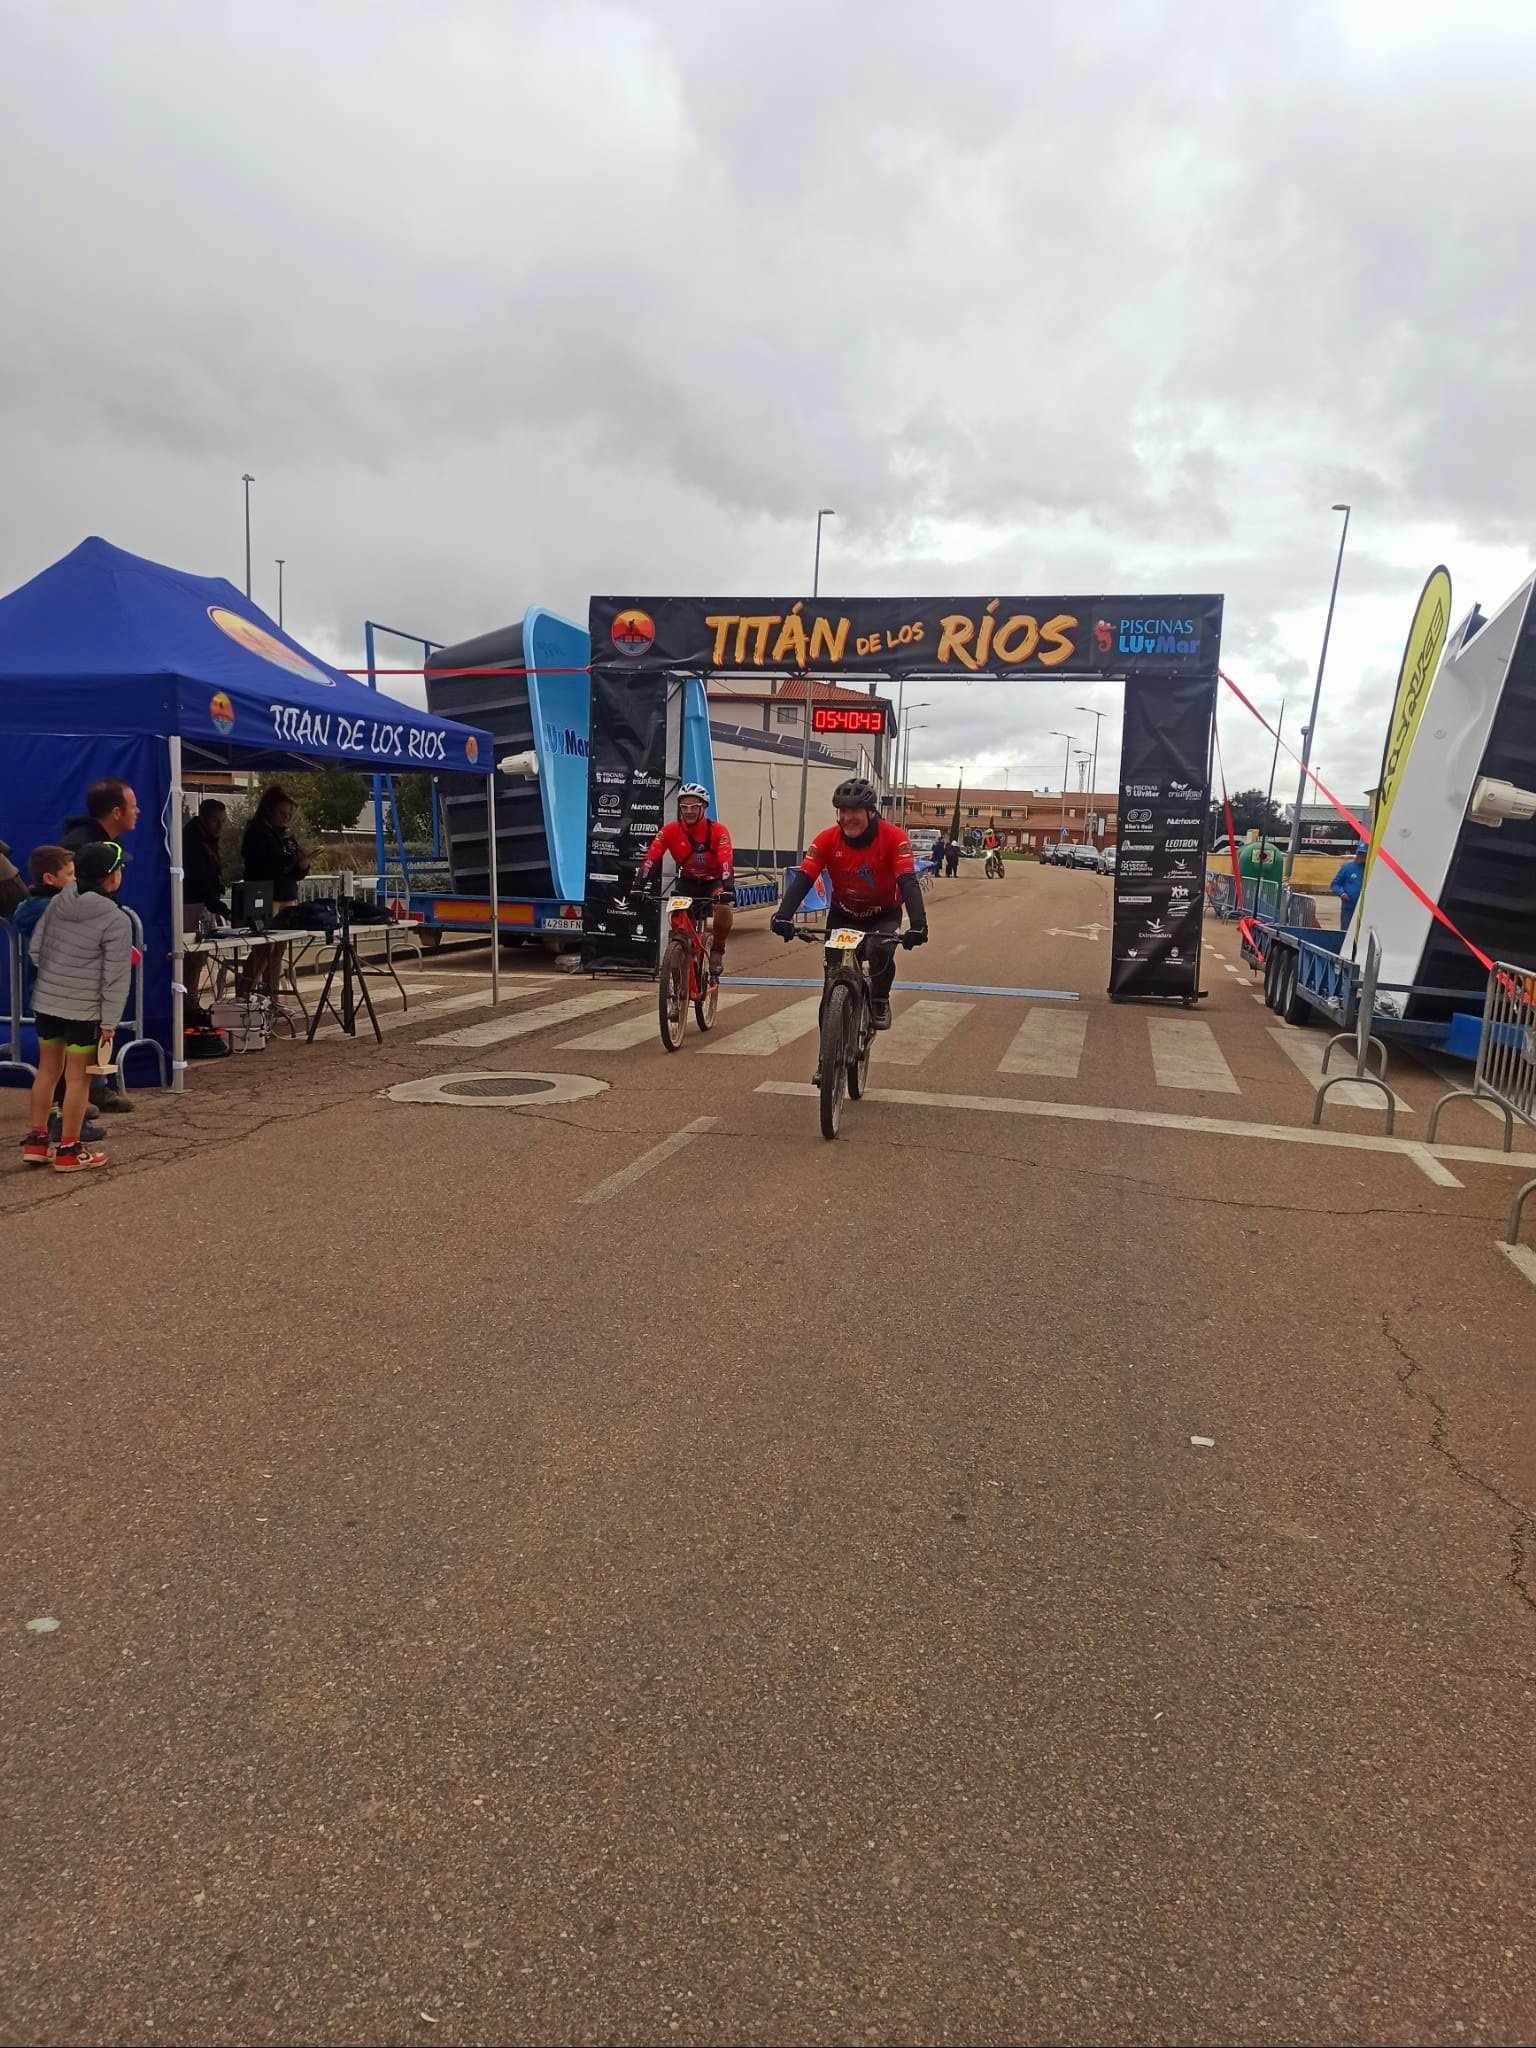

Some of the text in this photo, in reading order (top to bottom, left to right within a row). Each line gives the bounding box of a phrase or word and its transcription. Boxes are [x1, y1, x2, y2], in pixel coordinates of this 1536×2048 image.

[705, 598, 1079, 670] TITÁN DE LOS RÍOS
[1120, 619, 1194, 634] PISCINAS
[270, 704, 447, 761] TITAN DE LOS RIOS
